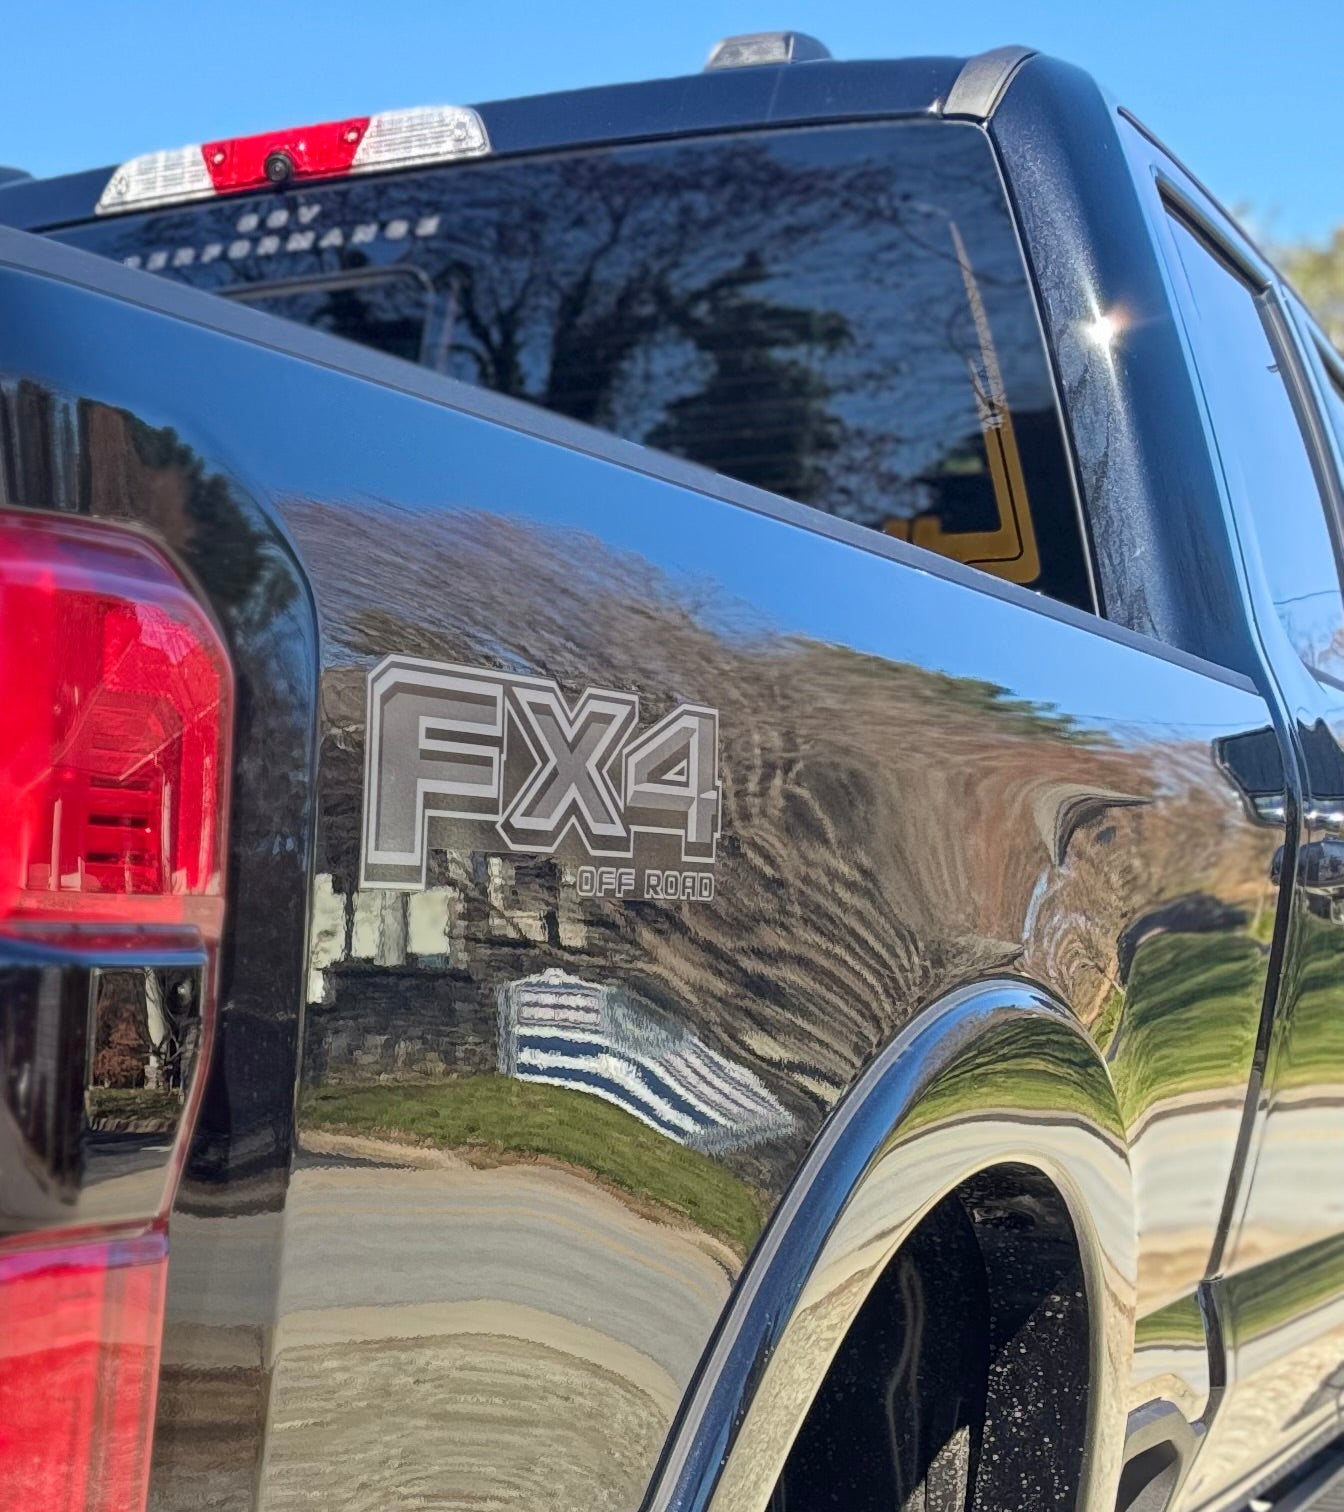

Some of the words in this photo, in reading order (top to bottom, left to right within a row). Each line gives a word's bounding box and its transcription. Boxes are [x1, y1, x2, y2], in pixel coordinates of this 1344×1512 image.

[359, 653, 722, 891] FX4
[576, 865, 636, 898] OFF
[643, 868, 716, 901] ROAD
